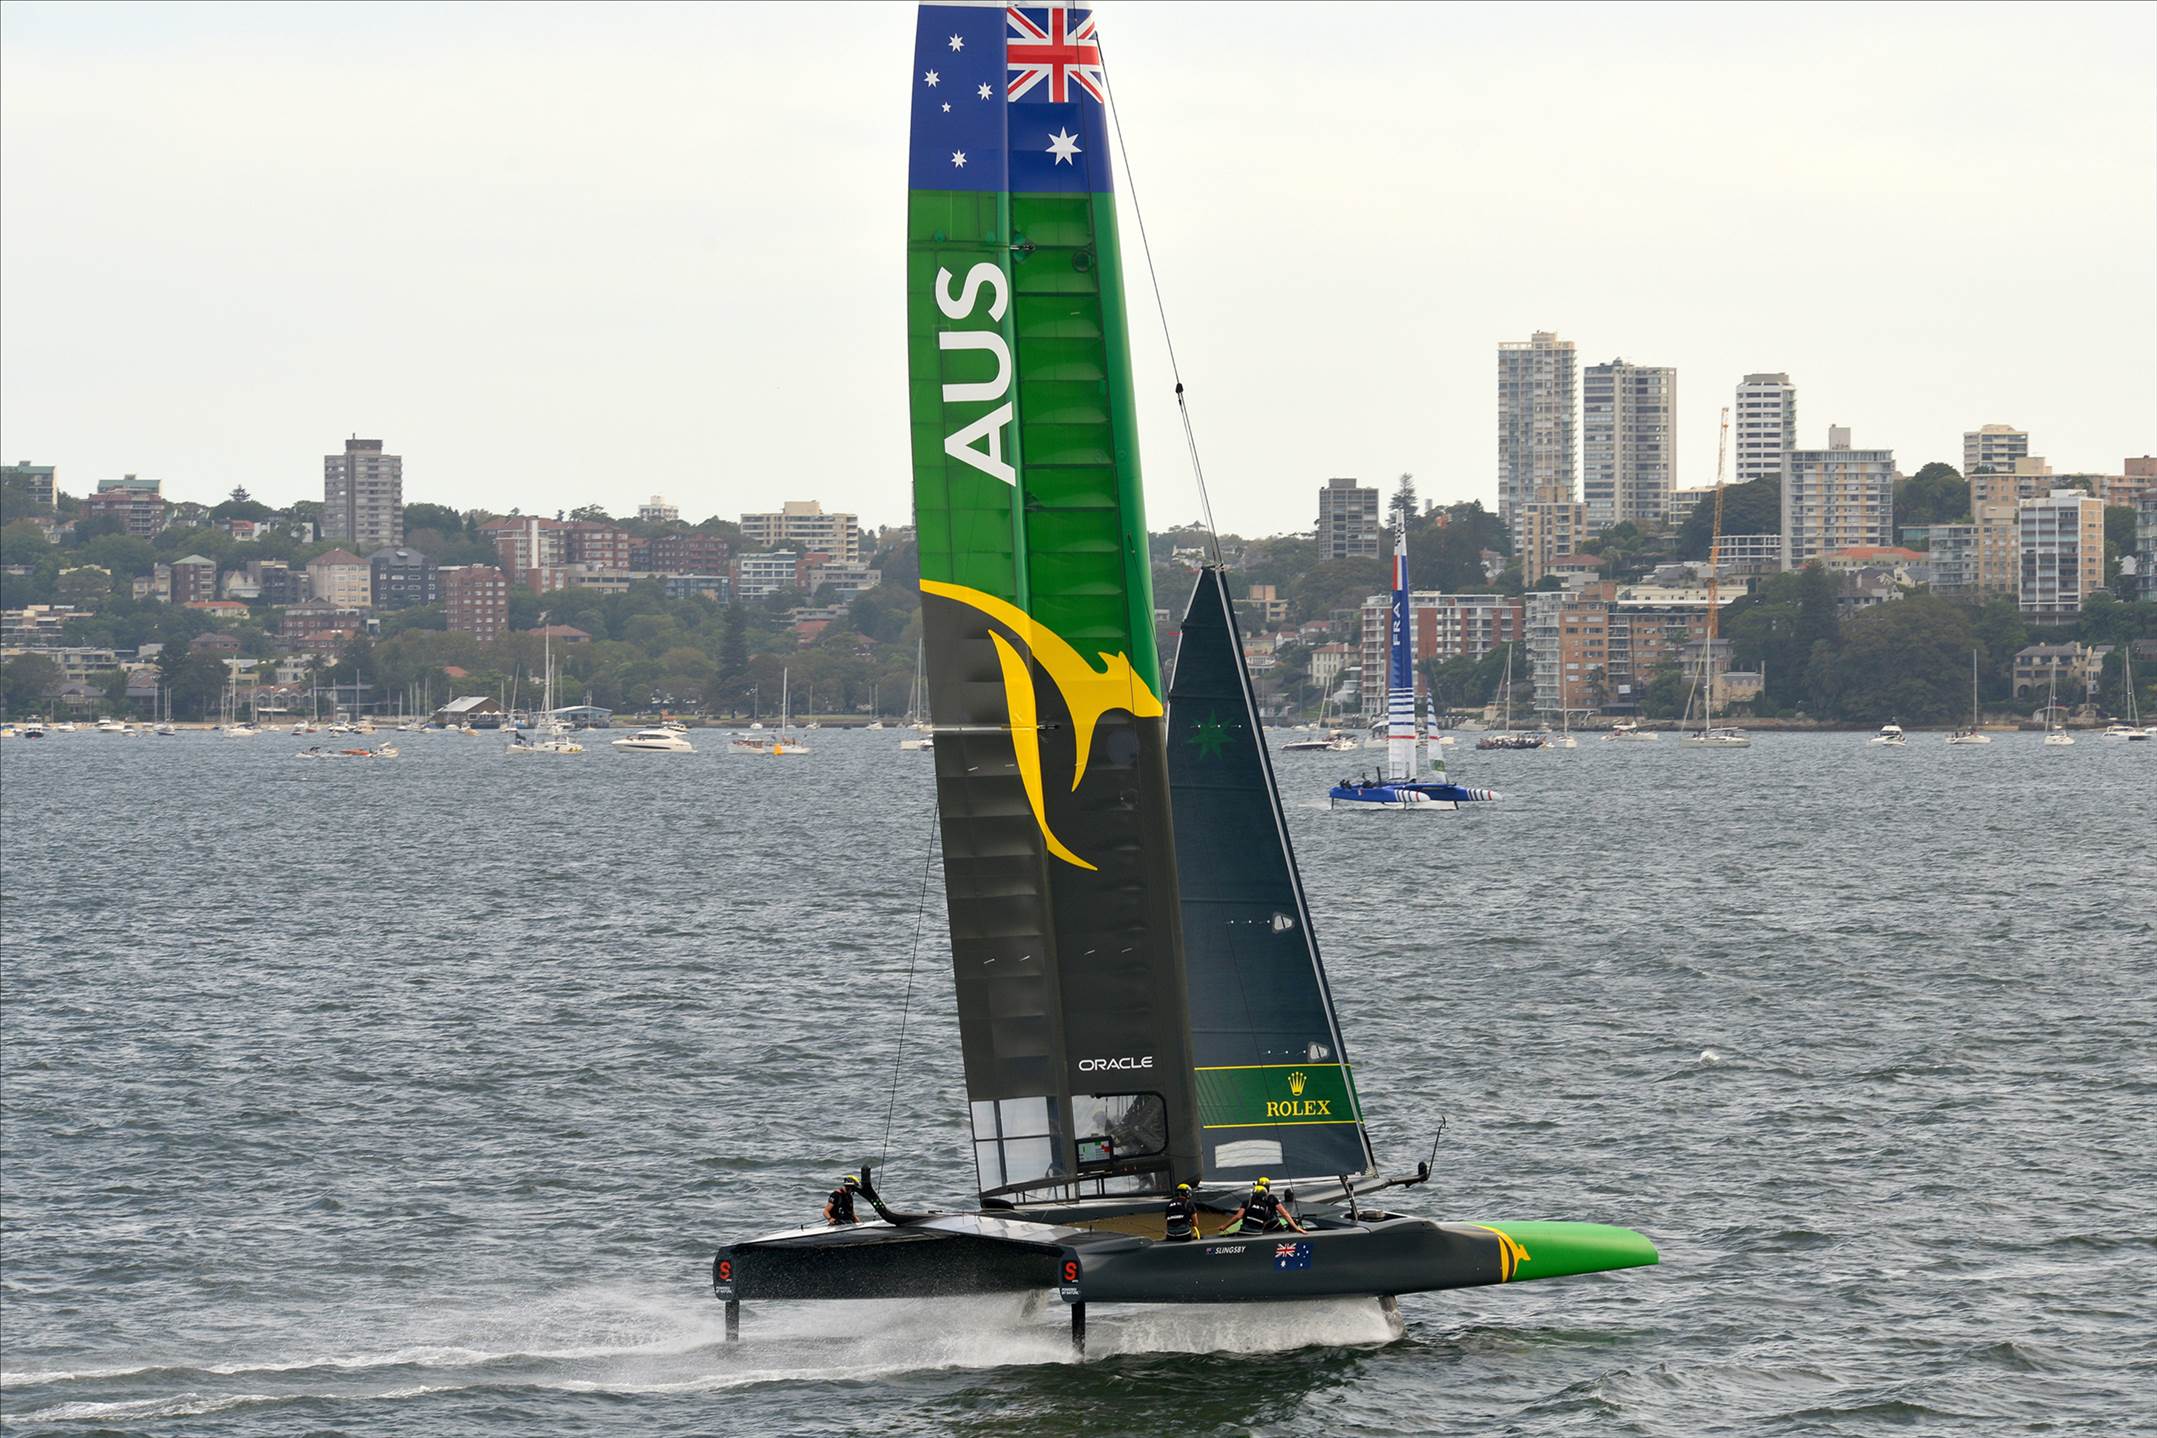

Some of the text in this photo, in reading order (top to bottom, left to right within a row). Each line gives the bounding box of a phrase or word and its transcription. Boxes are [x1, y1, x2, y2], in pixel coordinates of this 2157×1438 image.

[935, 262, 1016, 487] AUS
[1393, 602, 1401, 646] FRA
[1078, 1056, 1153, 1071] ORACLE
[1266, 1100, 1331, 1117] ROLEX
[1215, 1246, 1246, 1255] SLINGSBY
[720, 1261, 731, 1280] S
[1064, 1262, 1077, 1281] S
